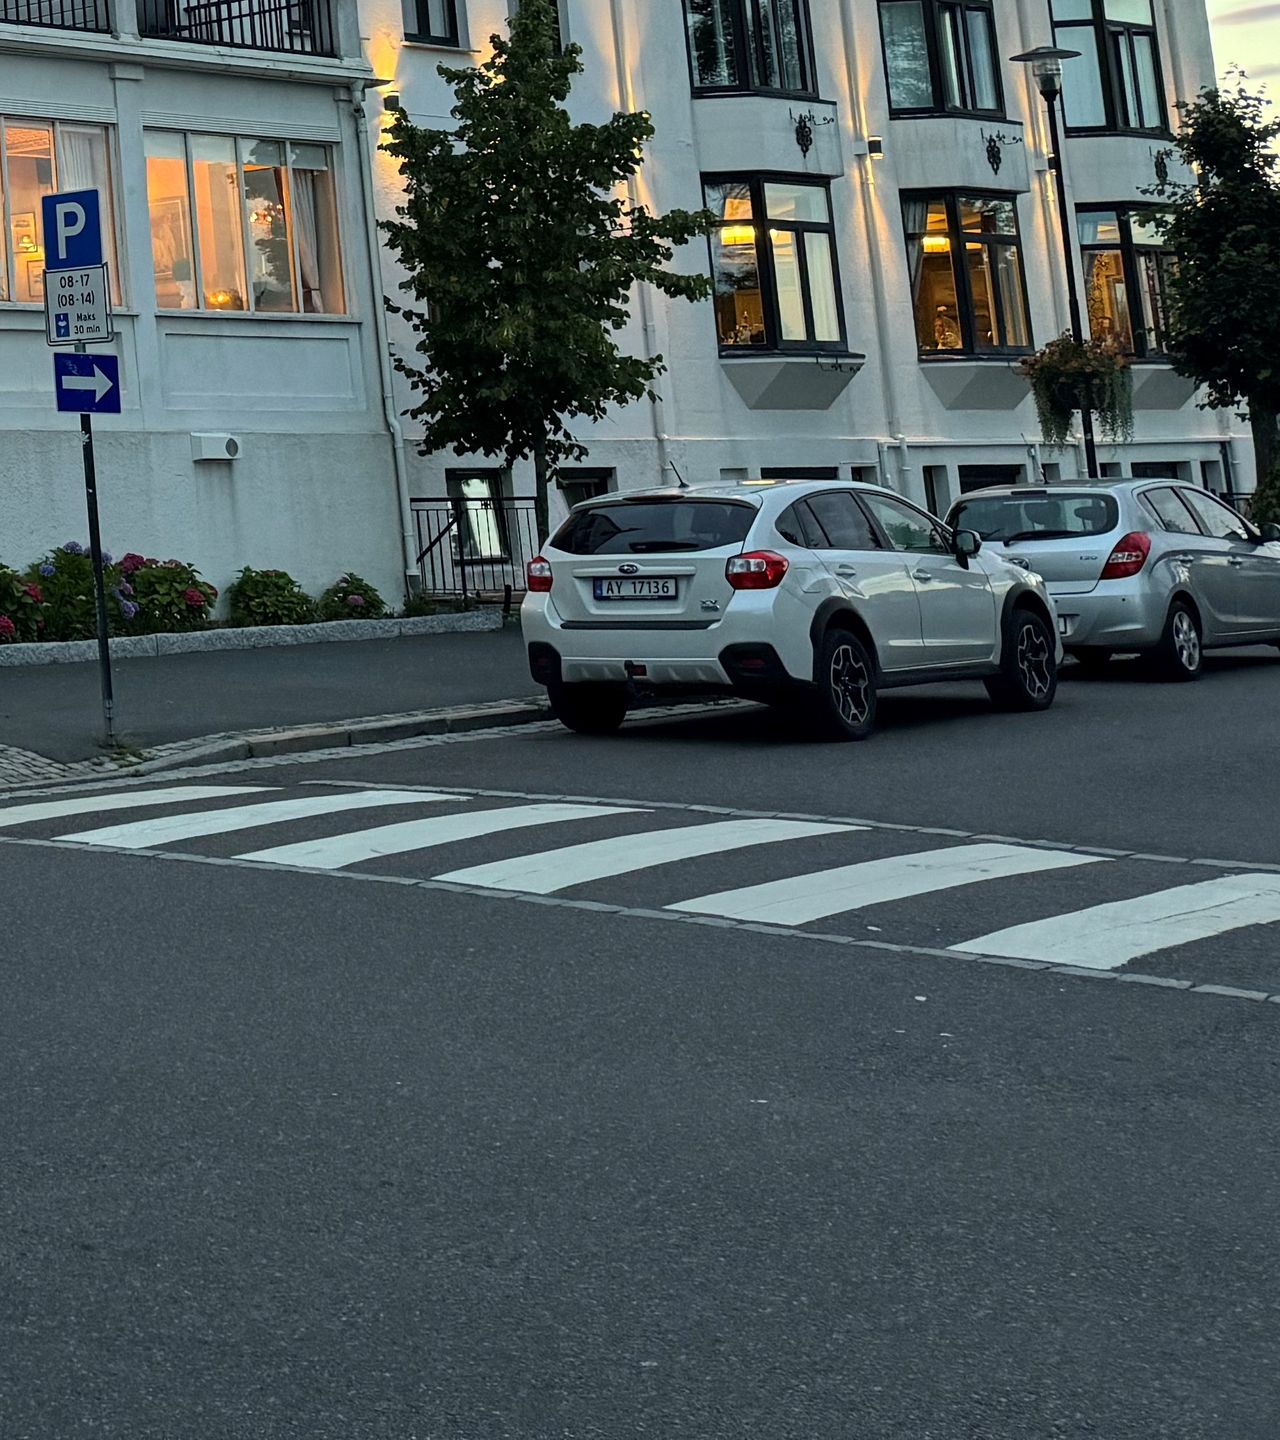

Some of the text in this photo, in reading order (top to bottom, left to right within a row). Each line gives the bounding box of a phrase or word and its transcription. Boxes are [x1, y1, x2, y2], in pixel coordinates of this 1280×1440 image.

[55, 201, 86, 260] P
[59, 274, 90, 288] 08-17
[57, 290, 95, 308] (08-14)
[76, 313, 96, 321] Maks
[74, 325, 100, 334] 30 min
[606, 581, 670, 594] AY 17136
